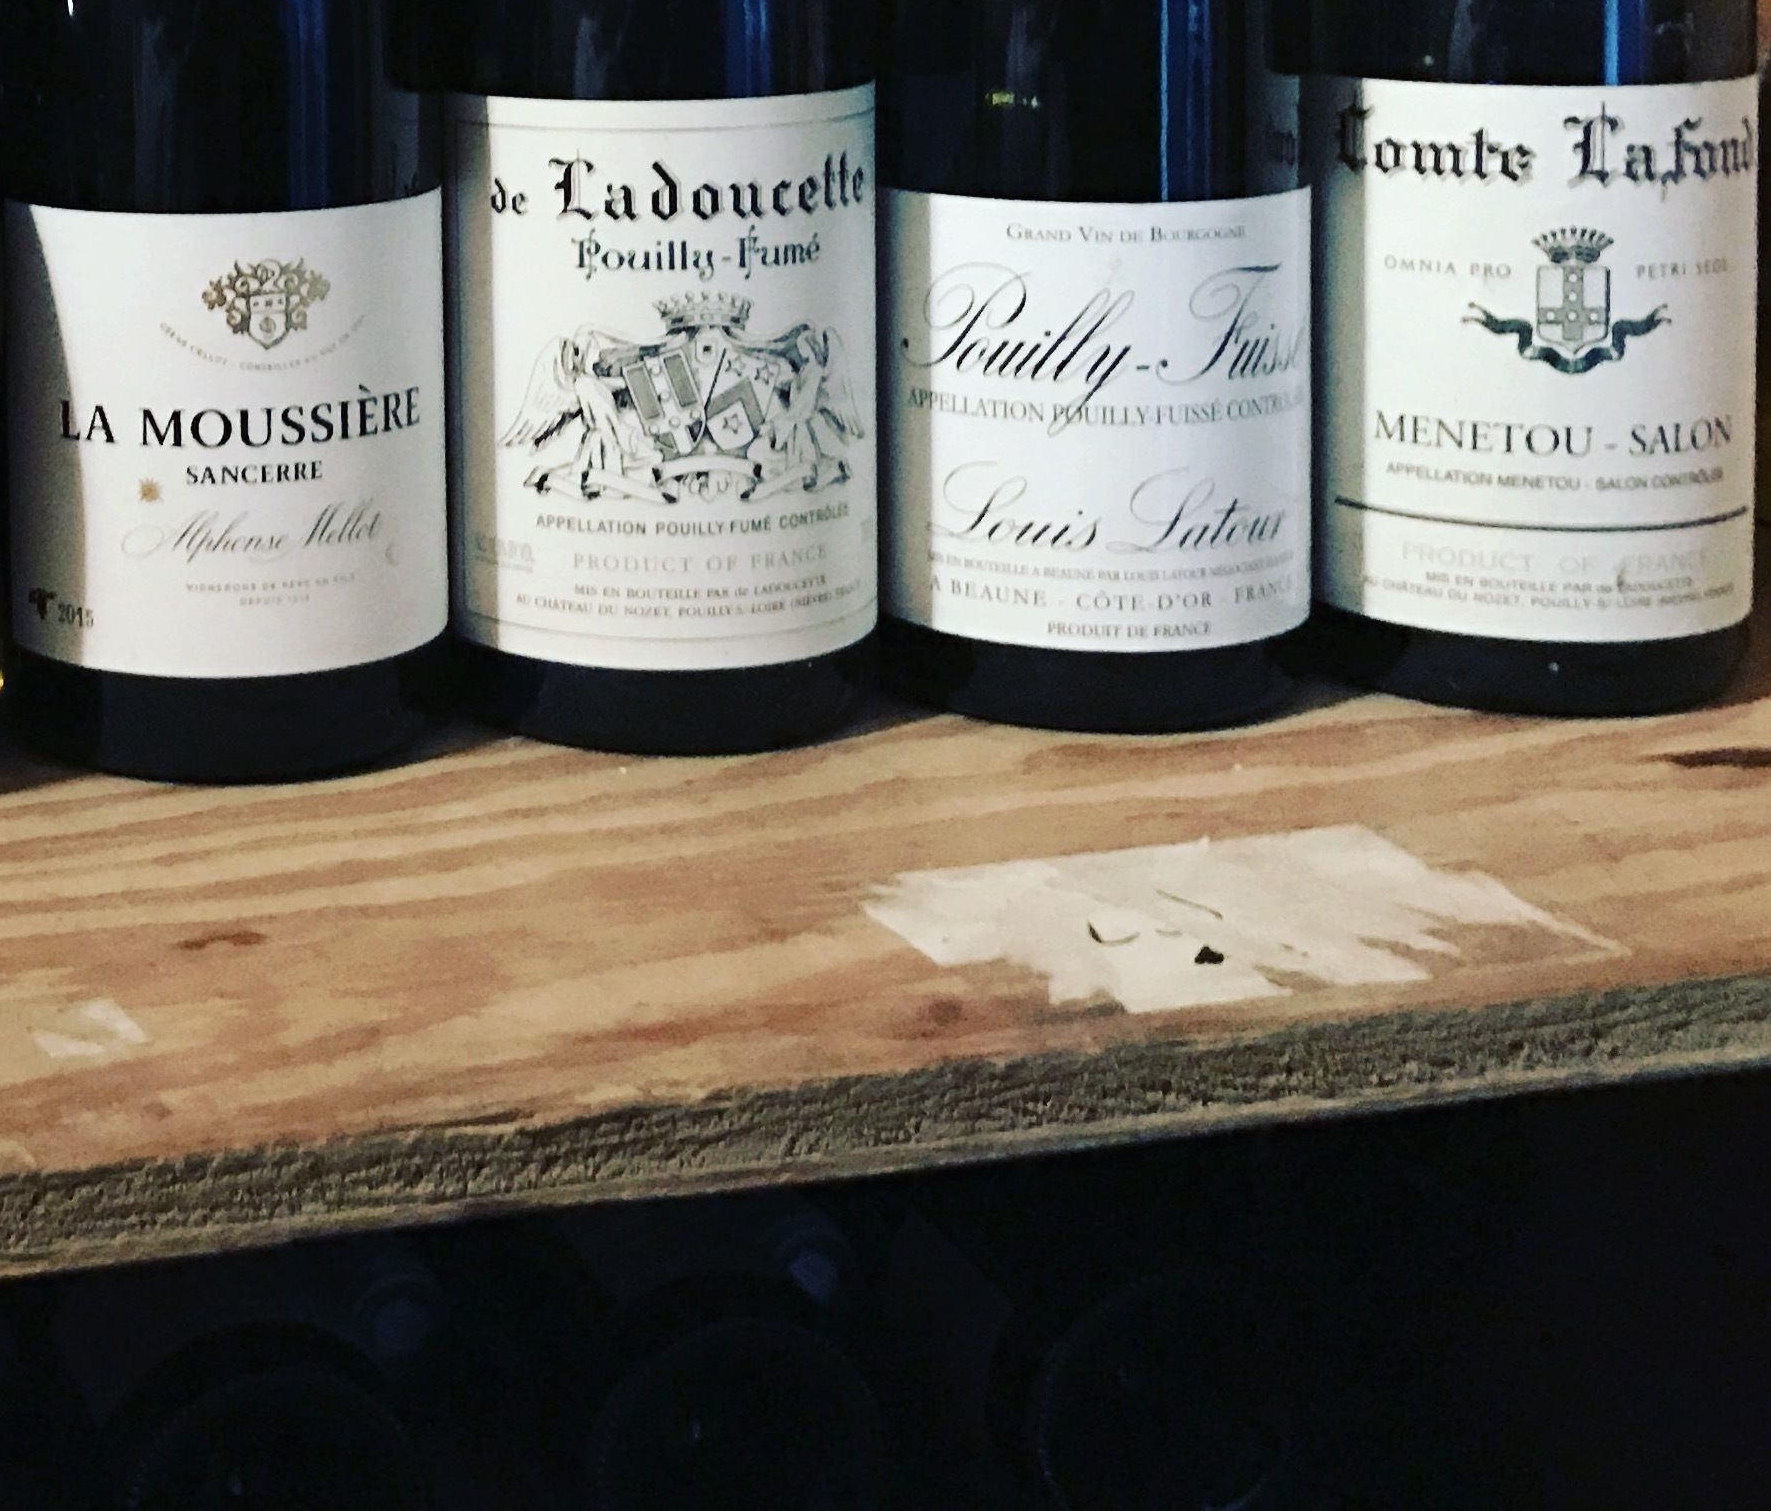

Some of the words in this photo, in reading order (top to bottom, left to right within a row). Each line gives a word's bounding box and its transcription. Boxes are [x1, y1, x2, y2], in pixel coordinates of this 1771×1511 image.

[1335, 102, 1536, 185] Comte
[490, 177, 529, 215] de
[548, 147, 865, 223] Ladoucette
[1006, 224, 1071, 243] GRAND
[1079, 225, 1115, 243] VIN
[1150, 224, 1247, 242] BOURGOGNE
[1384, 254, 1458, 277] OMNIA
[1470, 262, 1513, 280] PRO
[60, 399, 117, 444] LA
[139, 384, 422, 449] MOUSSIÈRE
[906, 388, 1045, 424] APPELLATION
[1226, 388, 1306, 421] CONTR
[1374, 409, 1593, 459] MENETOU
[1629, 414, 1733, 456] SALON
[186, 459, 324, 486] SANCERRE
[925, 459, 1103, 551] Louis
[1105, 466, 1286, 555] Latour
[121, 508, 290, 565] Alphonse
[302, 496, 383, 547] Mellot
[536, 512, 646, 536] APPELLATION
[573, 551, 694, 573] PRODUCT
[706, 554, 738, 573] OF
[750, 543, 829, 570] FRANCE
[534, 594, 593, 614] CHÂTEAU
[597, 602, 619, 616] DU
[603, 585, 620, 599] EN
[626, 587, 699, 600] BOUTEILLE
[706, 588, 729, 599] PAR
[950, 578, 1047, 607] BEAUNE
[1047, 621, 1119, 638] PRODUIT
[1126, 622, 1145, 638] DE
[1153, 620, 1212, 638] FRANCE
